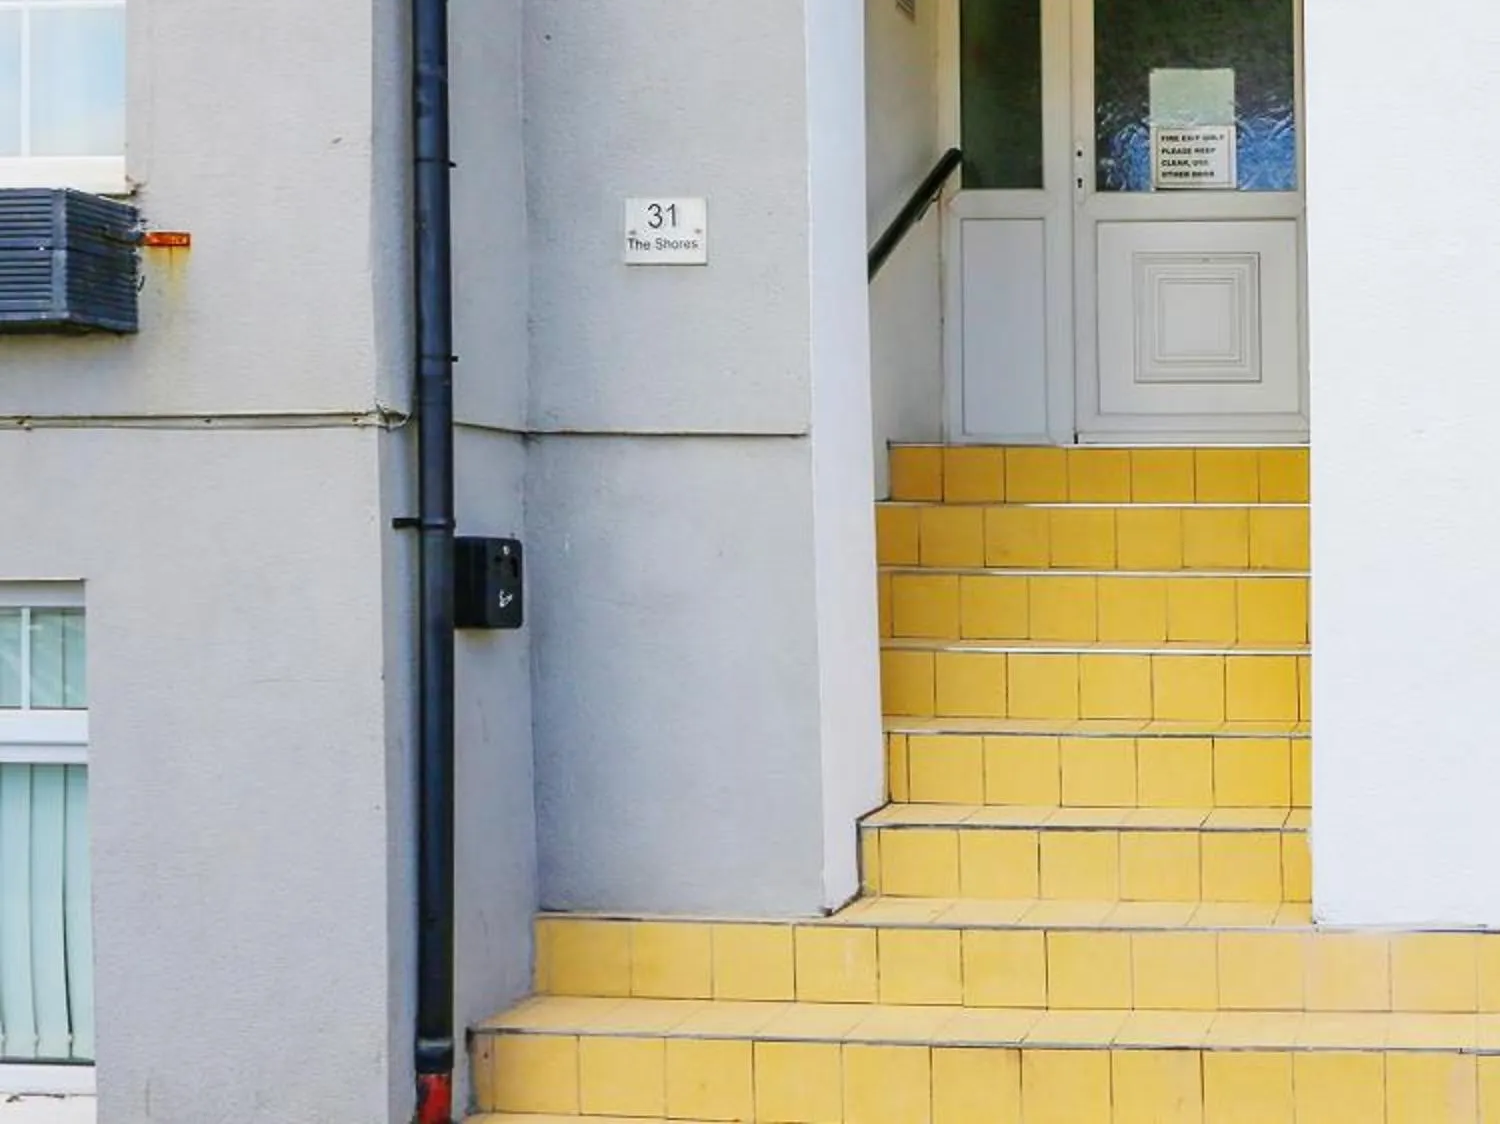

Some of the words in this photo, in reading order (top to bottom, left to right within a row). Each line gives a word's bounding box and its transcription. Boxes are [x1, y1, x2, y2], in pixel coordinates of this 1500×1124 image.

[647, 203, 677, 229] 31
[627, 237, 651, 251] The
[655, 237, 699, 251] Shores
